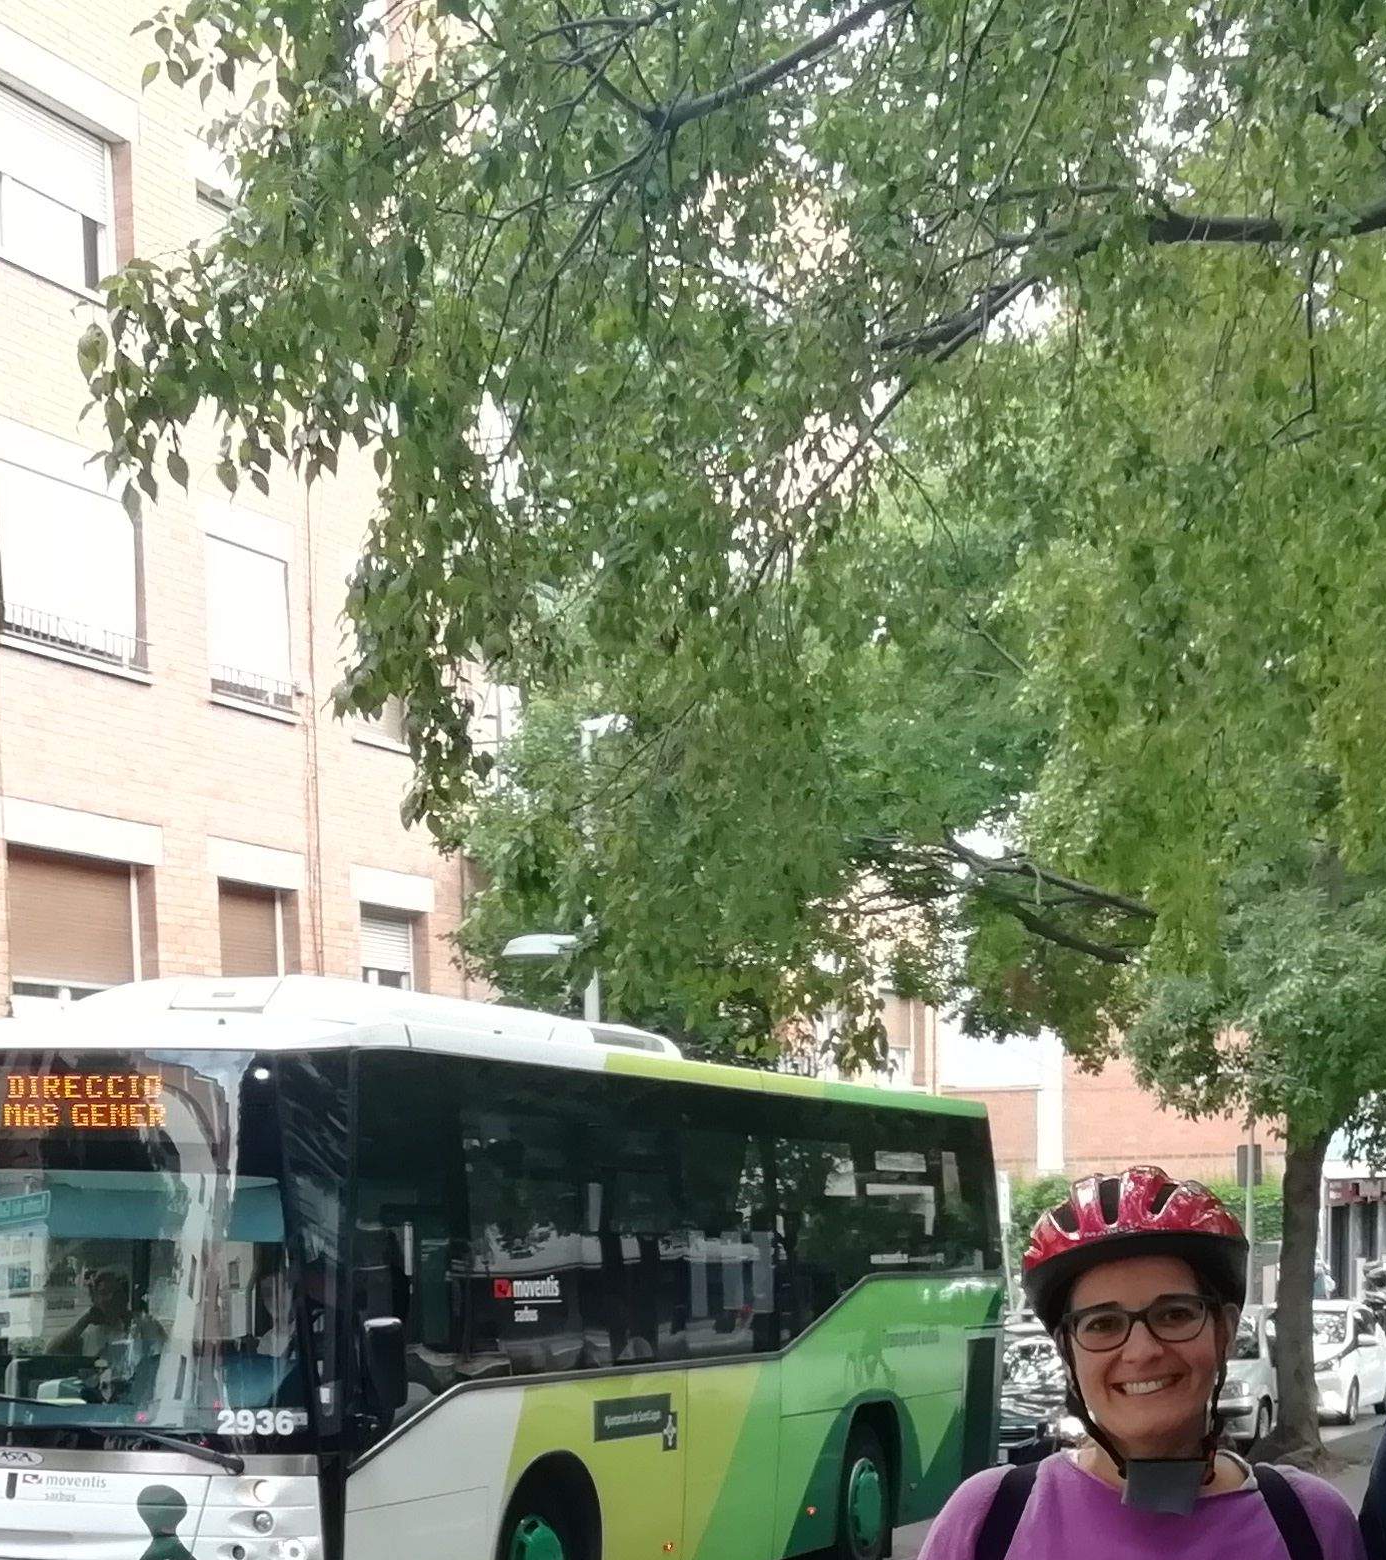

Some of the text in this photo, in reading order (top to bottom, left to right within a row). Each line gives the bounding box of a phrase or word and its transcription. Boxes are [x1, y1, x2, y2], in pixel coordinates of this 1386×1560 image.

[3, 1103, 168, 1128] MAS GENER
[216, 1408, 295, 1437] 2936
[45, 1474, 108, 1489] moventis
